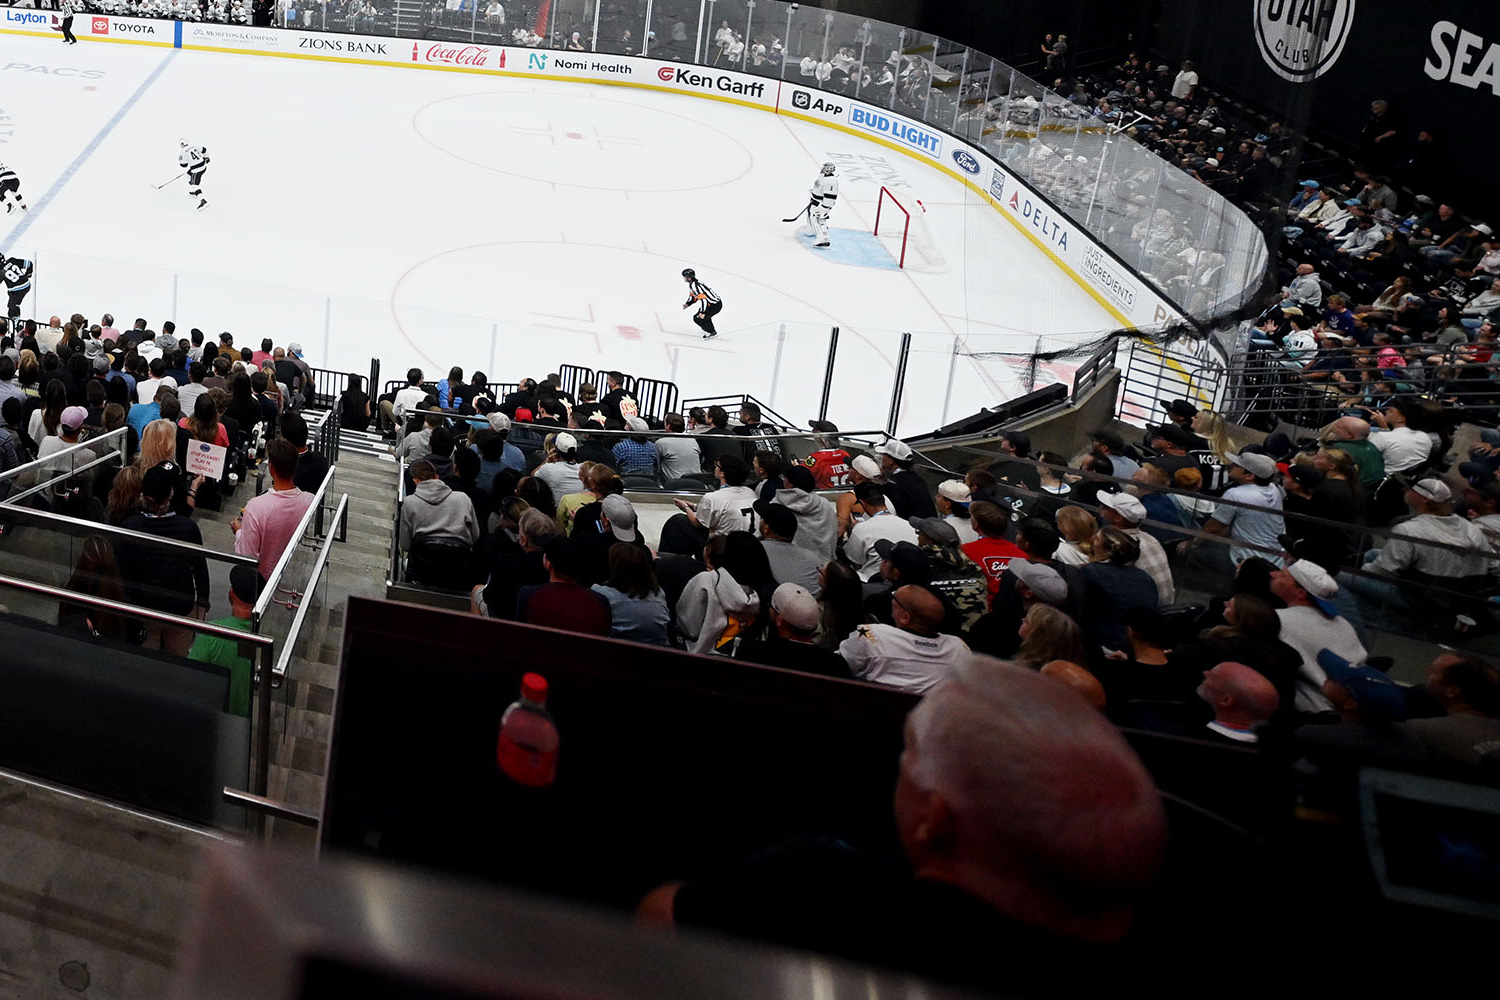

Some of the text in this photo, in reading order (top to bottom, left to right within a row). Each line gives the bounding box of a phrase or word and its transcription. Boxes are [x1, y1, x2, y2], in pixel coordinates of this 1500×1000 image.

[6, 10, 47, 25] Layton
[112, 22, 155, 35] TOYOTA
[299, 37, 388, 56] ZIONS BANK
[1275, 39, 1310, 64] CLUB
[3, 62, 107, 79] PACS
[554, 58, 633, 75] Nomi Health
[675, 68, 765, 99] Ken Garff
[852, 108, 940, 152] BUD LIGHT
[956, 151, 977, 172] Ford
[1022, 200, 1069, 251] DELTA
[4, 264, 23, 283] 93
[1084, 257, 1134, 306] INGREDIENTS
